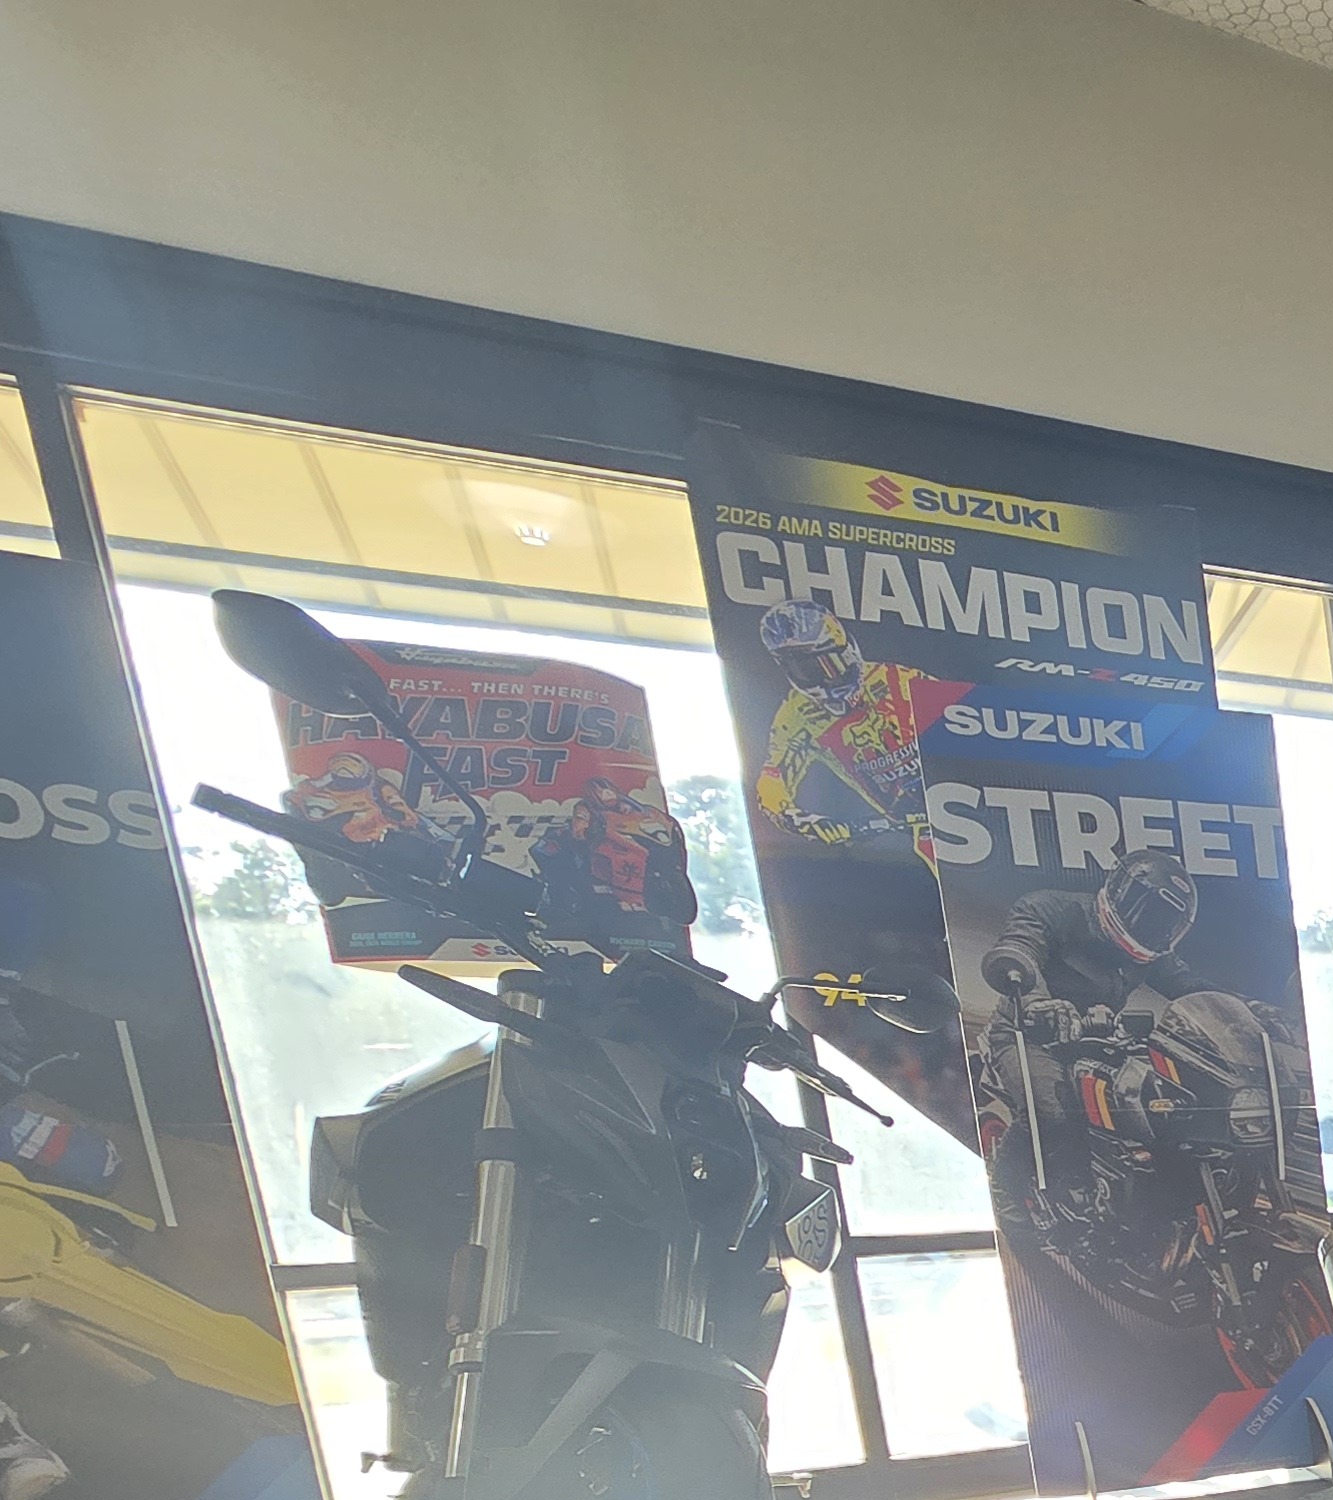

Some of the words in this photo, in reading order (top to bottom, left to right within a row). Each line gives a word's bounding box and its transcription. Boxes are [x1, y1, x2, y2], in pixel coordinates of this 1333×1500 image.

[716, 504, 772, 530] 2026
[777, 516, 823, 538] AMA
[828, 522, 956, 556] SUPERCROSS
[912, 487, 1060, 534] SUZUKI
[715, 531, 1204, 666] CHAMPION
[471, 682, 525, 696] THEN
[532, 685, 609, 705] THERE'S
[944, 704, 1145, 751] SUZUKI
[402, 744, 568, 809] FAST
[854, 740, 918, 773] PROGRESSIV
[925, 782, 1284, 879] STREET
[813, 972, 867, 1007] 94
[1246, 1394, 1284, 1436] GSX-8TT
